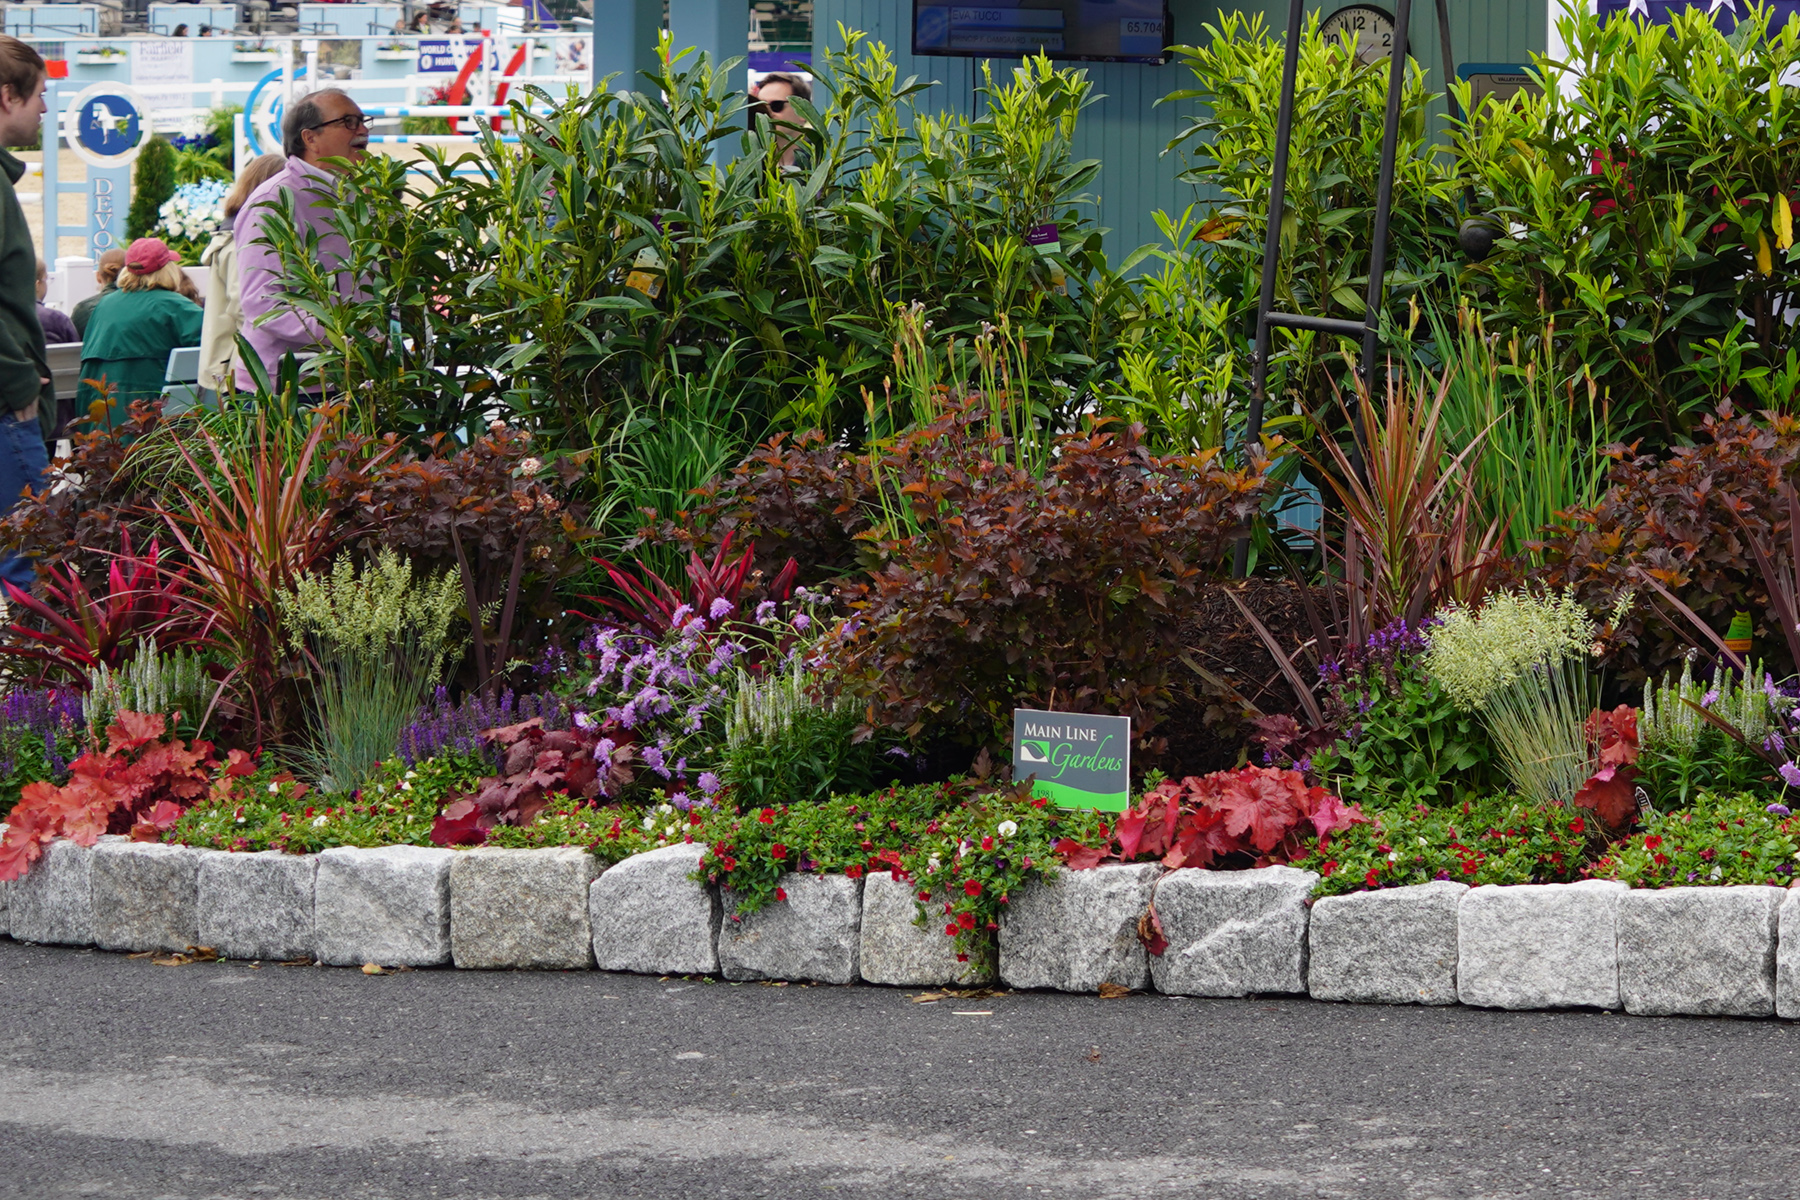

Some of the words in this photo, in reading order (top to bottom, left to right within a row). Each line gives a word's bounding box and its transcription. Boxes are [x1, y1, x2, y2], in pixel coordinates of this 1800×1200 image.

[952, 10, 971, 21] EVA
[973, 11, 1002, 21] TUCCI
[1127, 21, 1163, 34] 65.704
[1353, 16, 1366, 30] 12
[1382, 32, 1392, 47] 2
[421, 45, 446, 55] WORLD
[1024, 722, 1062, 739] MAIN
[1066, 725, 1098, 742] LINE
[1051, 734, 1124, 779] Gardens
[1036, 789, 1055, 798] 1981
